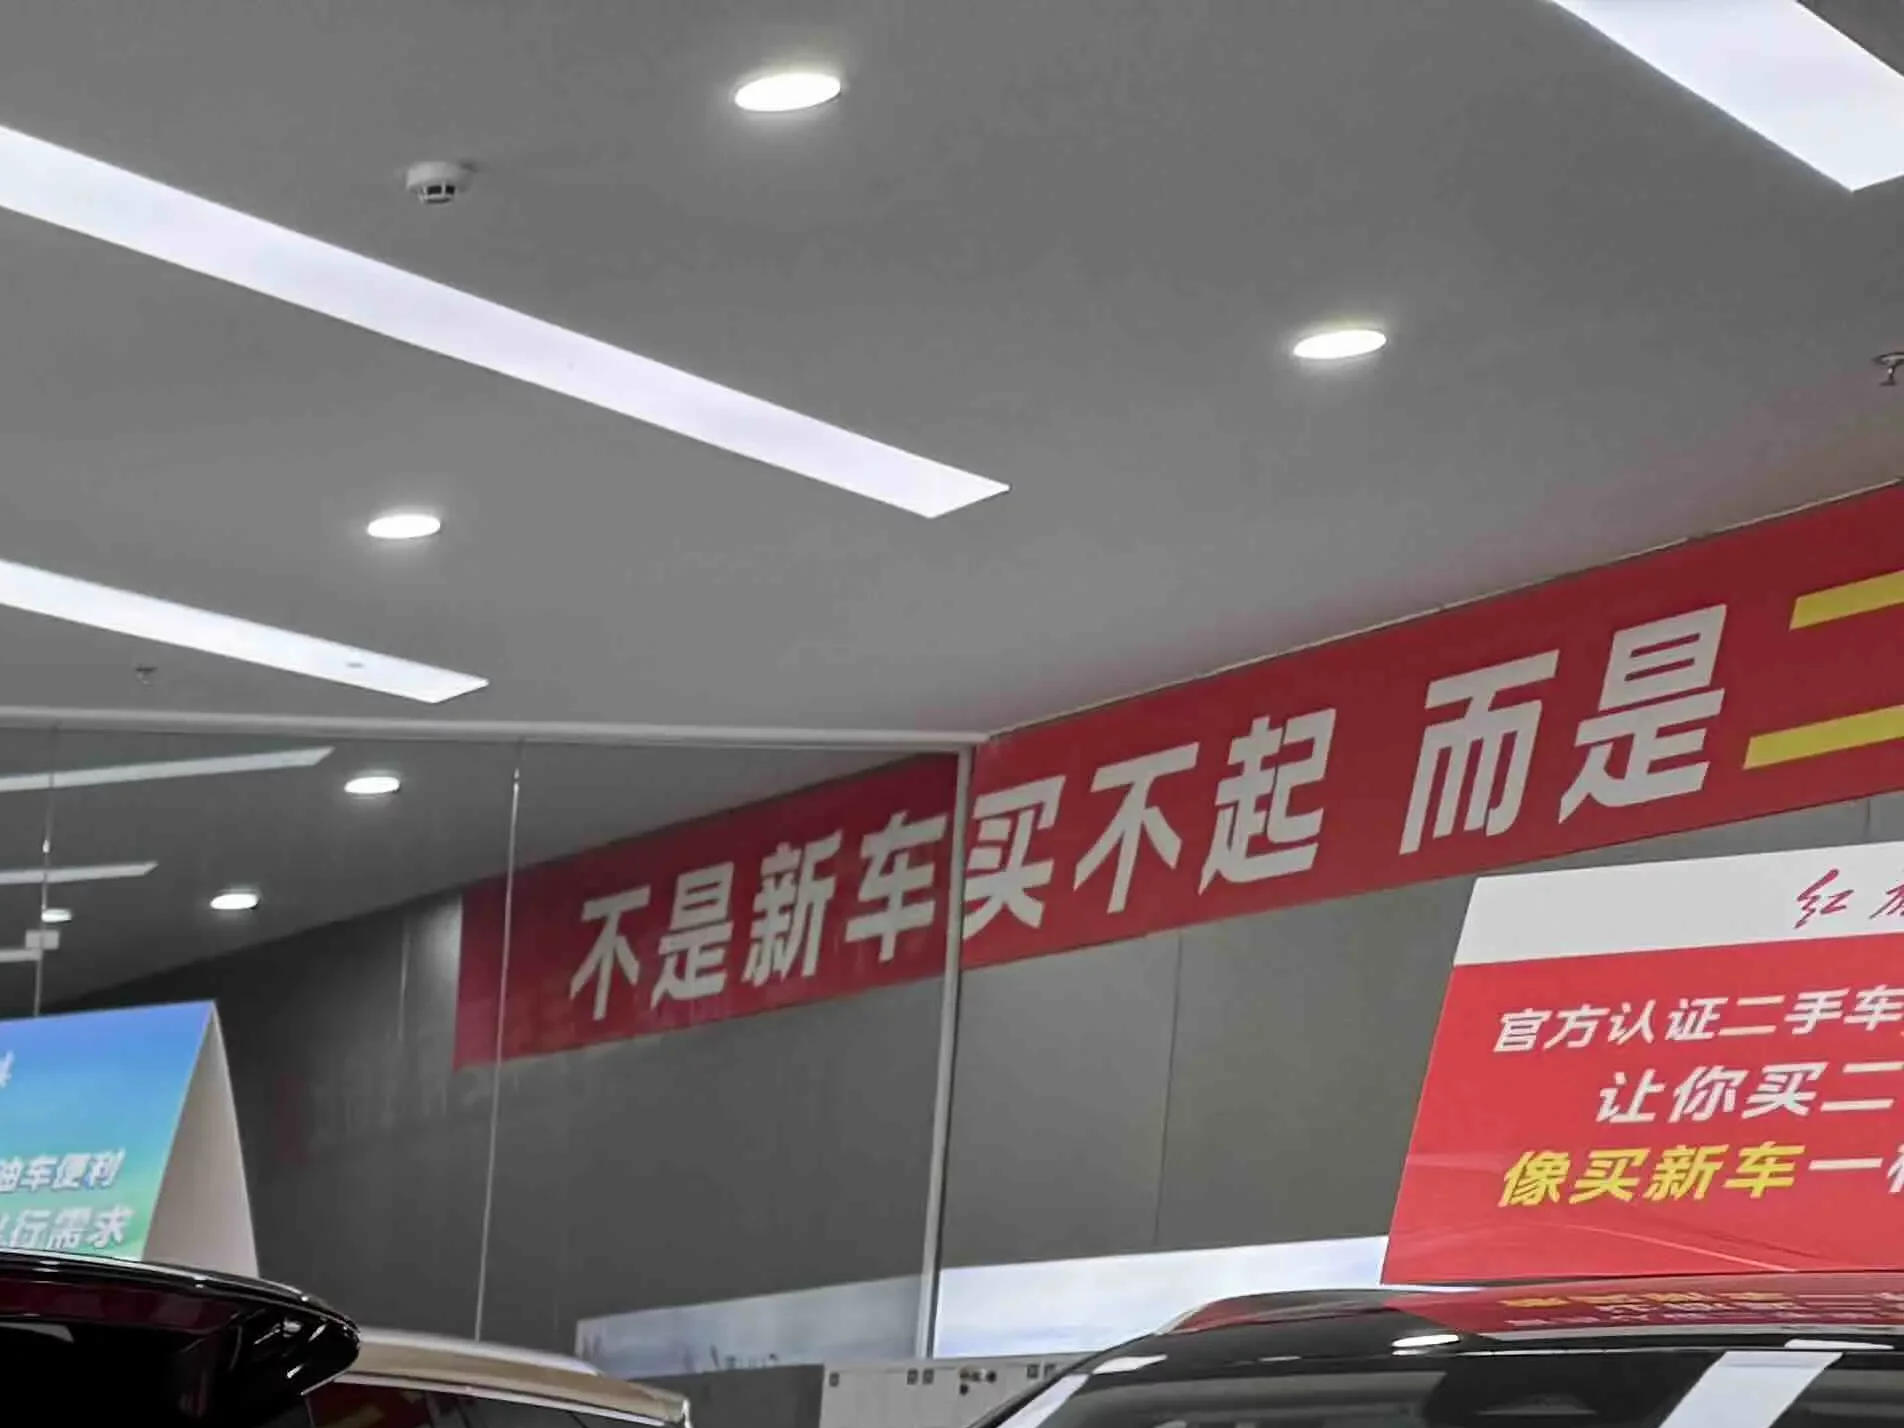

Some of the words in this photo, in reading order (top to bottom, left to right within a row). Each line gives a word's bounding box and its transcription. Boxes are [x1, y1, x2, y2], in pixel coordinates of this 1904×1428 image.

[569, 707, 1336, 1021] 不是新车买不起
[1493, 984, 1904, 1053] 官方认证二手车
[1596, 1061, 1904, 1125] 让你买二
[1498, 1141, 1904, 1207] 像买新车一
